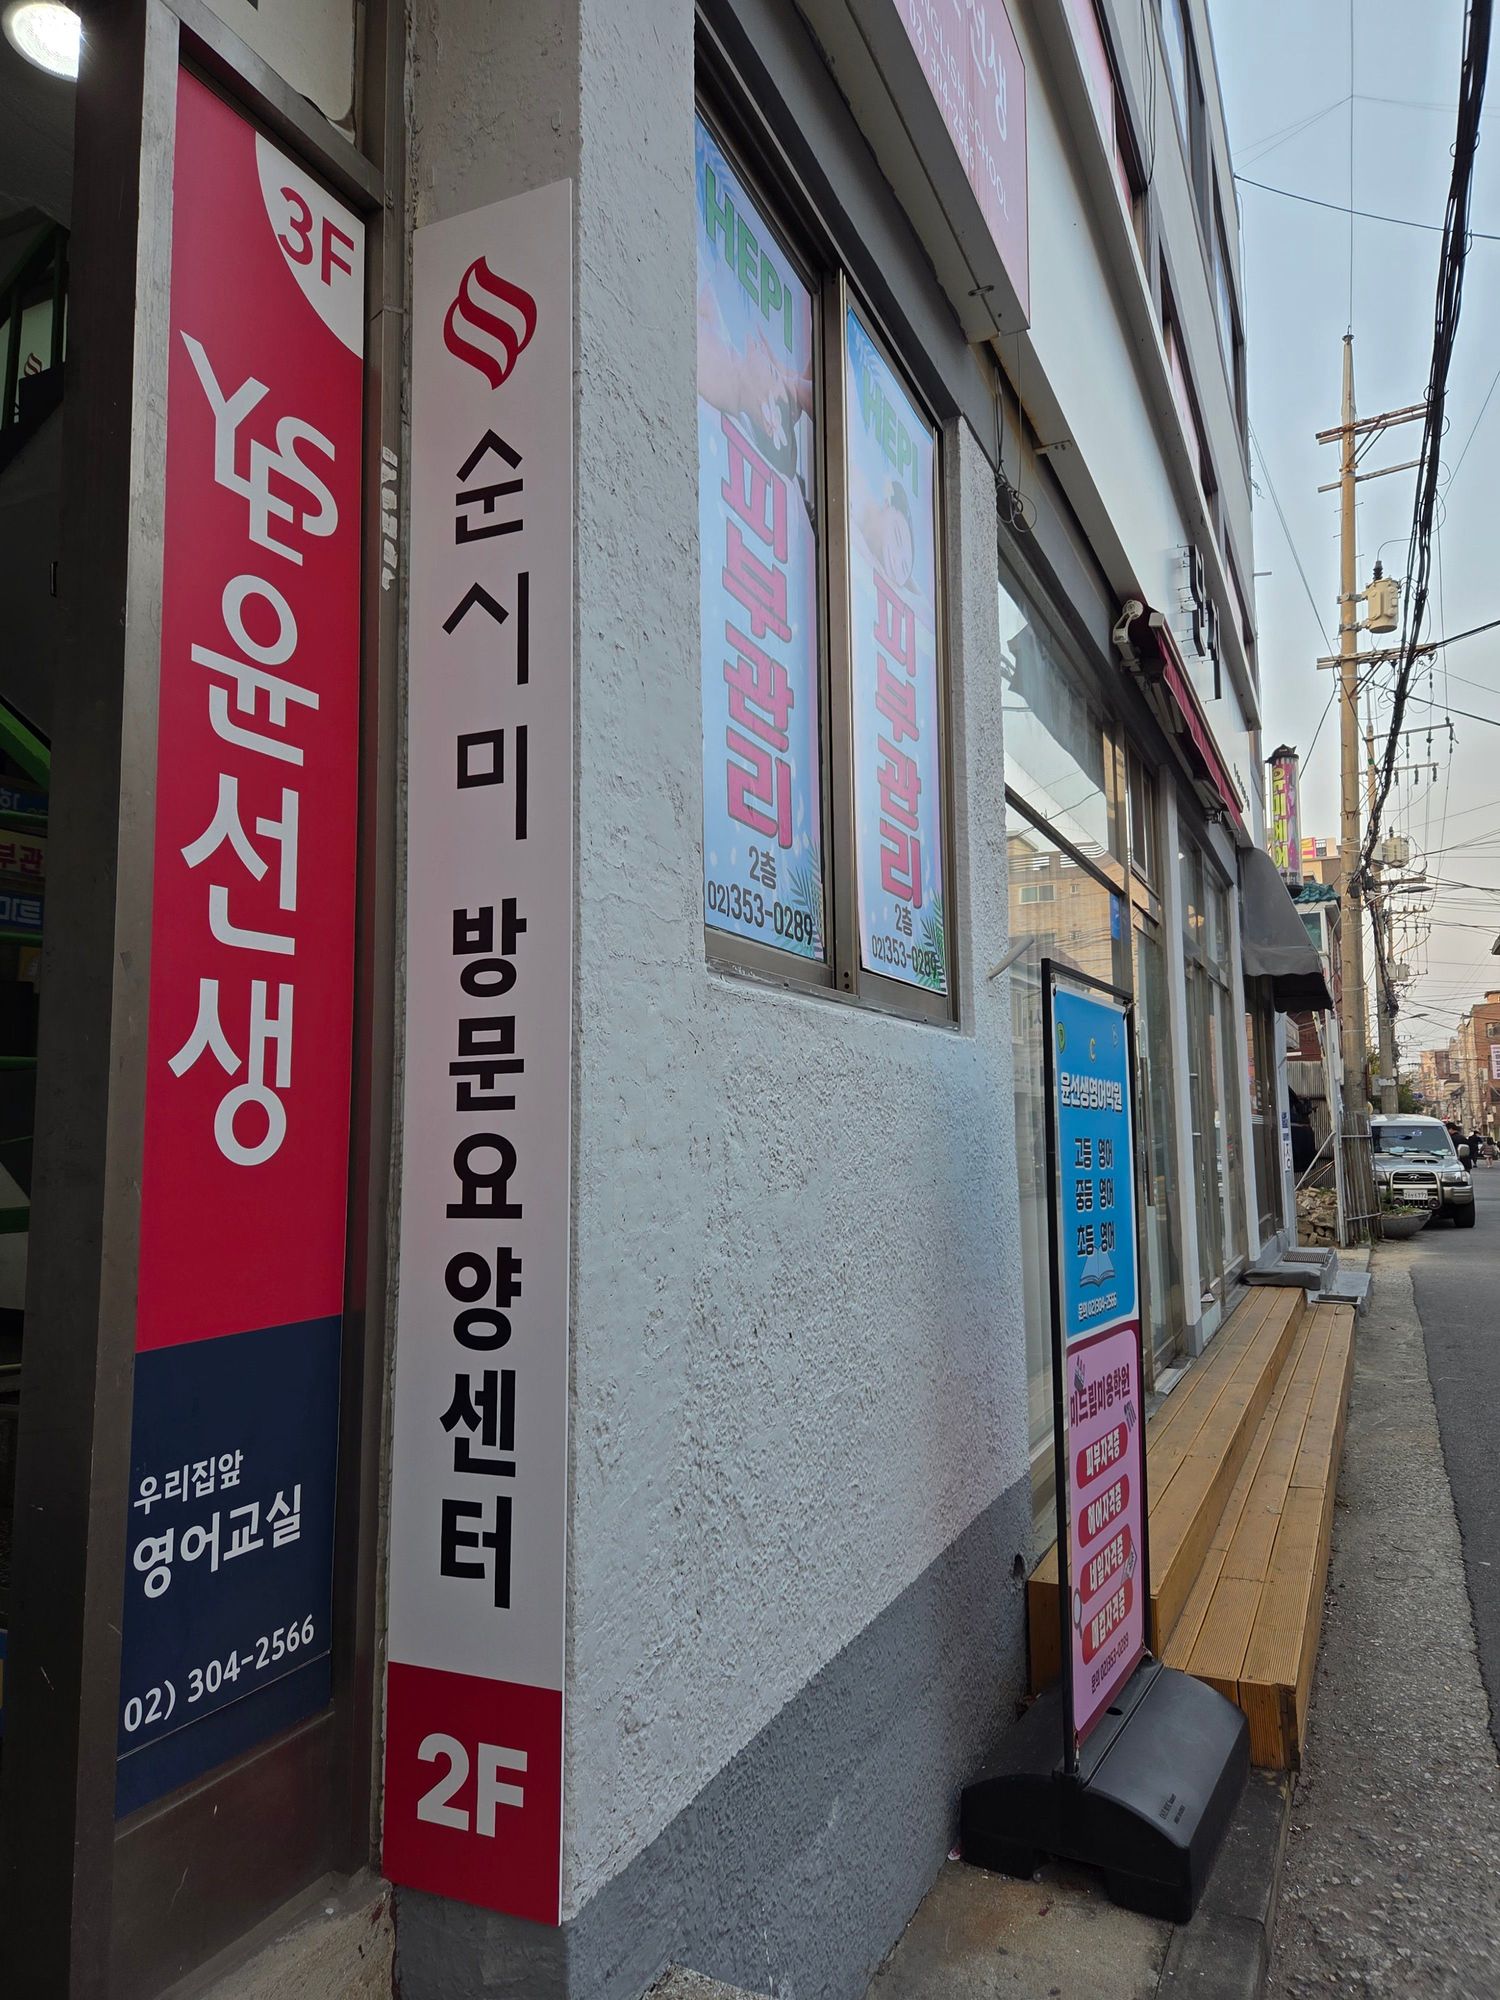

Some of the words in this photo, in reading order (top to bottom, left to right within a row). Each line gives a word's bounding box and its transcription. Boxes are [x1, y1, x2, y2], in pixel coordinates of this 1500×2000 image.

[929, 50, 976, 173] 304-2566
[967, 101, 1010, 221] SCHOOL
[277, 185, 356, 288] 3F
[705, 162, 794, 354] HEPI
[861, 371, 919, 493] HEPI
[721, 408, 795, 851] 피부관리
[873, 567, 923, 910] 피부관리
[168, 573, 319, 1167] 윤선생
[748, 844, 777, 891] 2층
[706, 880, 815, 947] 02)353-0289
[894, 901, 914, 936] 2층
[1060, 1071, 1123, 1112] 윤선생영어학원
[1074, 1137, 1093, 1169] 고등
[1098, 1138, 1114, 1170] 영어
[1075, 1179, 1093, 1213] 중등
[1099, 1178, 1115, 1209] 영어
[438, 897, 529, 1610] 방문요양센터
[1076, 1224, 1095, 1257] 초등
[1100, 1223, 1116, 1256] 영어
[1078, 1302, 1088, 1321] 문의
[1069, 1362, 1131, 1429] 미드림미용학원
[133, 1448, 245, 1515] 우리집앞
[1085, 1427, 1121, 1478] 피부자격증
[132, 1483, 303, 1600] 영어교실
[1087, 1481, 1122, 1536] 헤어자격증
[1089, 1533, 1124, 1592] 네일자격증
[123, 1678, 177, 1733] 02)
[187, 1612, 316, 1707] 304-2566
[1091, 1664, 1101, 1695] 문의
[416, 1731, 529, 1839] 2F
